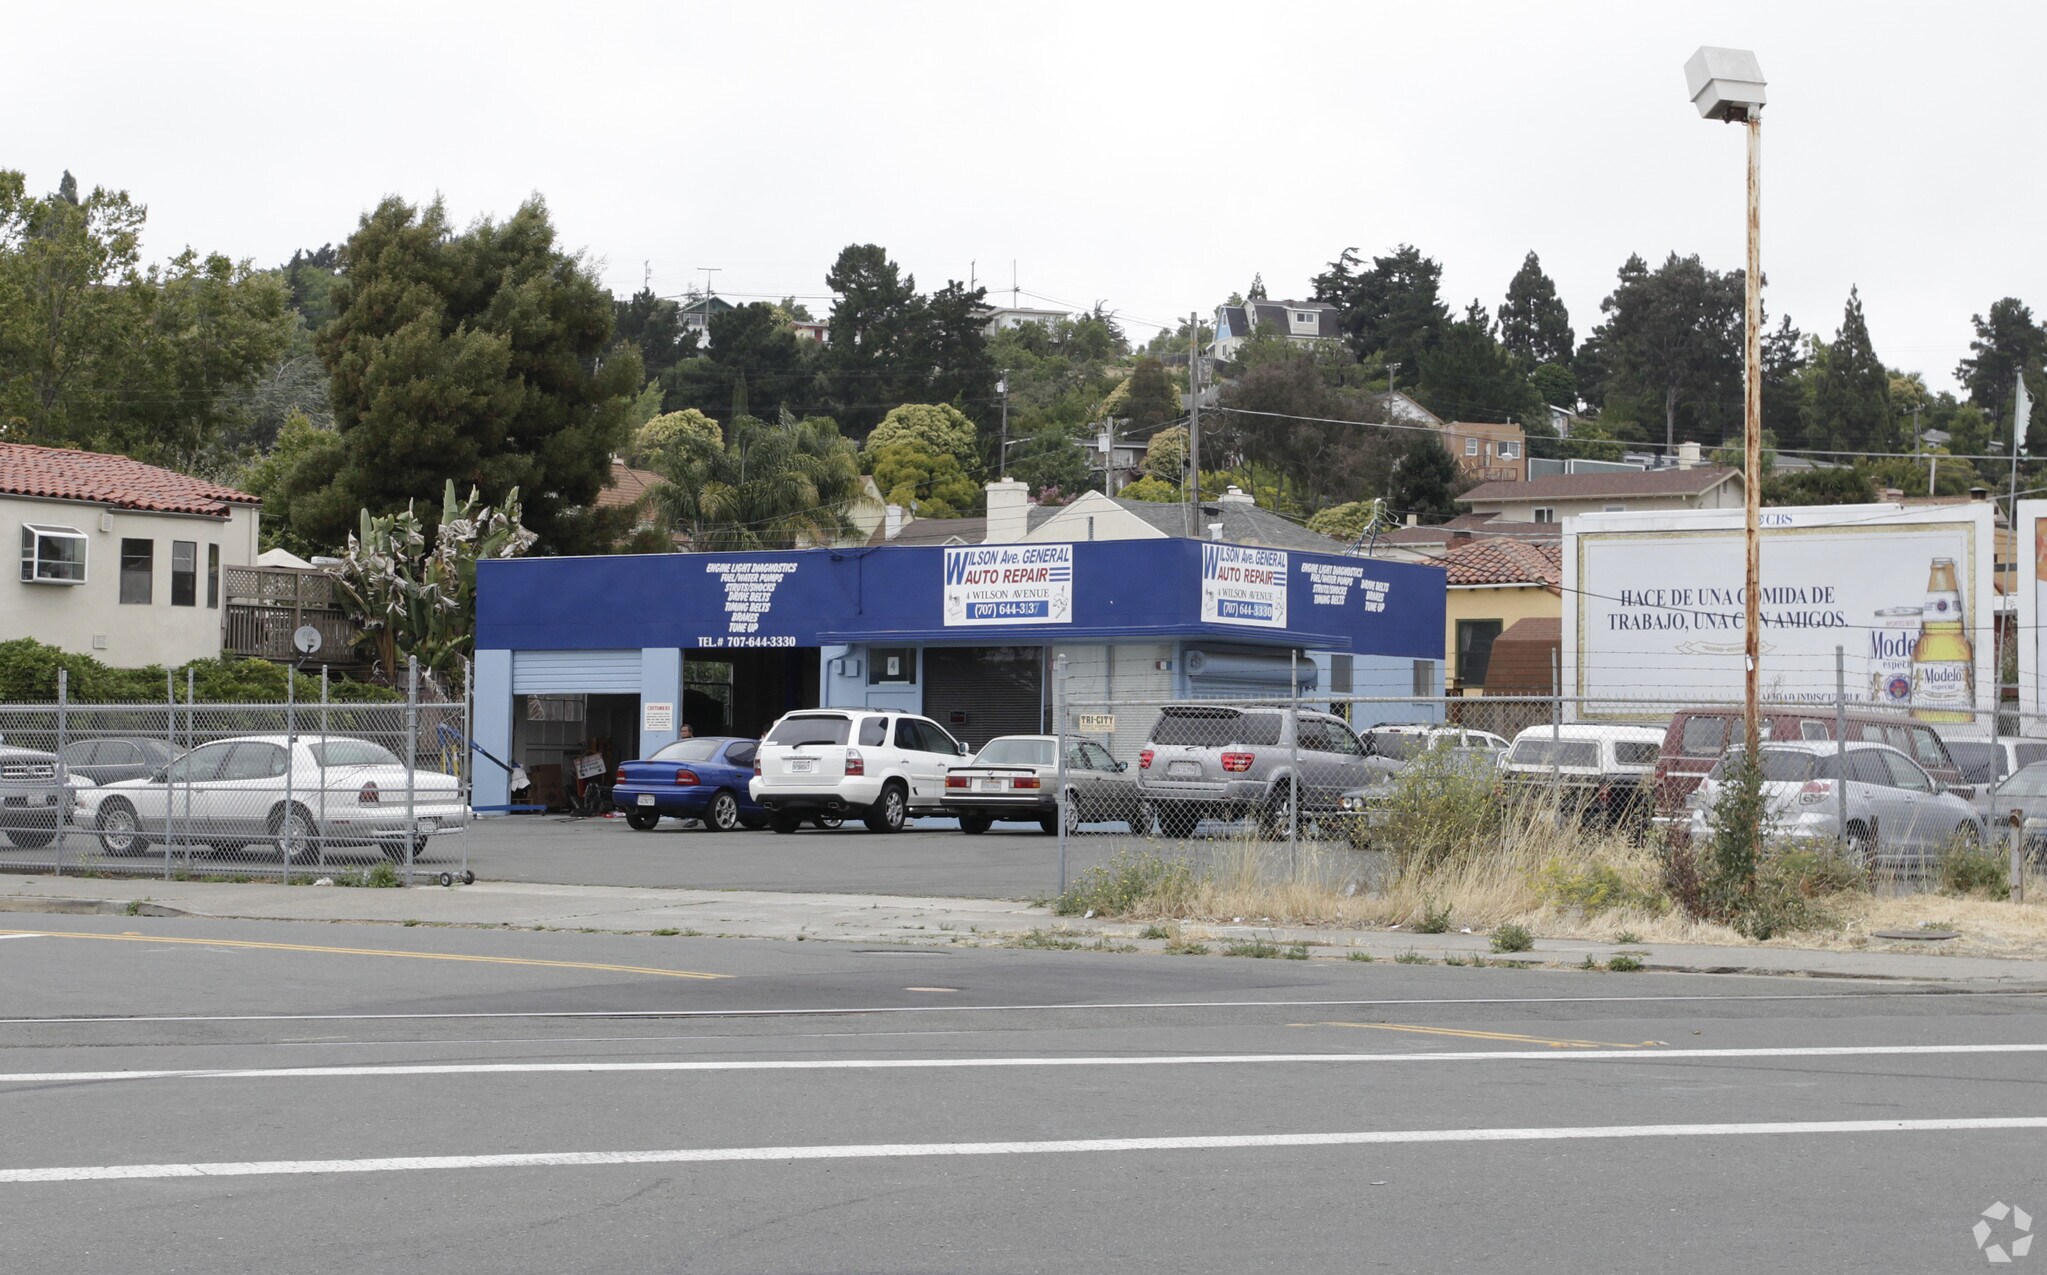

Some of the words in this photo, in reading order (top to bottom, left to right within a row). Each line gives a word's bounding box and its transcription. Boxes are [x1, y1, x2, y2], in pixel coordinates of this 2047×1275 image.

[1766, 513, 1793, 526] CBS
[706, 563, 731, 573] ENGINE
[731, 563, 752, 573] LIGHT
[751, 563, 798, 573] DIAGNOSTICS
[946, 550, 999, 586] WILSON
[1000, 550, 1020, 564] Ave.
[1022, 547, 1070, 564] GENERAL
[1204, 545, 1240, 580] WILSON
[1241, 550, 1254, 564] Ave.
[1255, 550, 1286, 568] GENERAL
[759, 573, 784, 583] PUMPS
[964, 569, 999, 585] AUTO
[1002, 567, 1049, 584] REPAIR
[1217, 566, 1241, 583] AUTO
[1243, 568, 1274, 586] REPAIR
[727, 592, 750, 602] DRIVE
[749, 592, 771, 602] BELTS
[972, 590, 1009, 600] WILSON
[1012, 588, 1050, 599] AVENUE
[1222, 588, 1247, 598] WILSON
[1248, 589, 1273, 601] AVENUE
[1620, 589, 1666, 606] HACE
[1671, 588, 1693, 606] DE
[1699, 587, 1733, 606] UNA
[1737, 586, 1808, 606] CMIDA
[1812, 586, 1835, 604] DE
[724, 602, 749, 612] TIMING
[749, 602, 771, 612] BELTS
[974, 603, 997, 618] (707)
[1223, 601, 1239, 617] (707)
[1240, 603, 1272, 618] 644-3330
[1377, 602, 1386, 613] UP
[731, 612, 760, 622] BRAKES
[1607, 612, 1689, 633] TRABAJO,
[1694, 612, 1729, 630] UNA
[1732, 611, 1769, 630] CN
[1773, 610, 1849, 629] AMIGOS.
[728, 622, 747, 633] TUNE
[747, 623, 759, 633] UP
[727, 636, 797, 647] 707-644-3330
[1871, 630, 1920, 660] Mode
[1924, 667, 1962, 684] Modelo
[1761, 692, 1796, 701] ALIDAD
[1081, 715, 1114, 725] TRI-CITY
